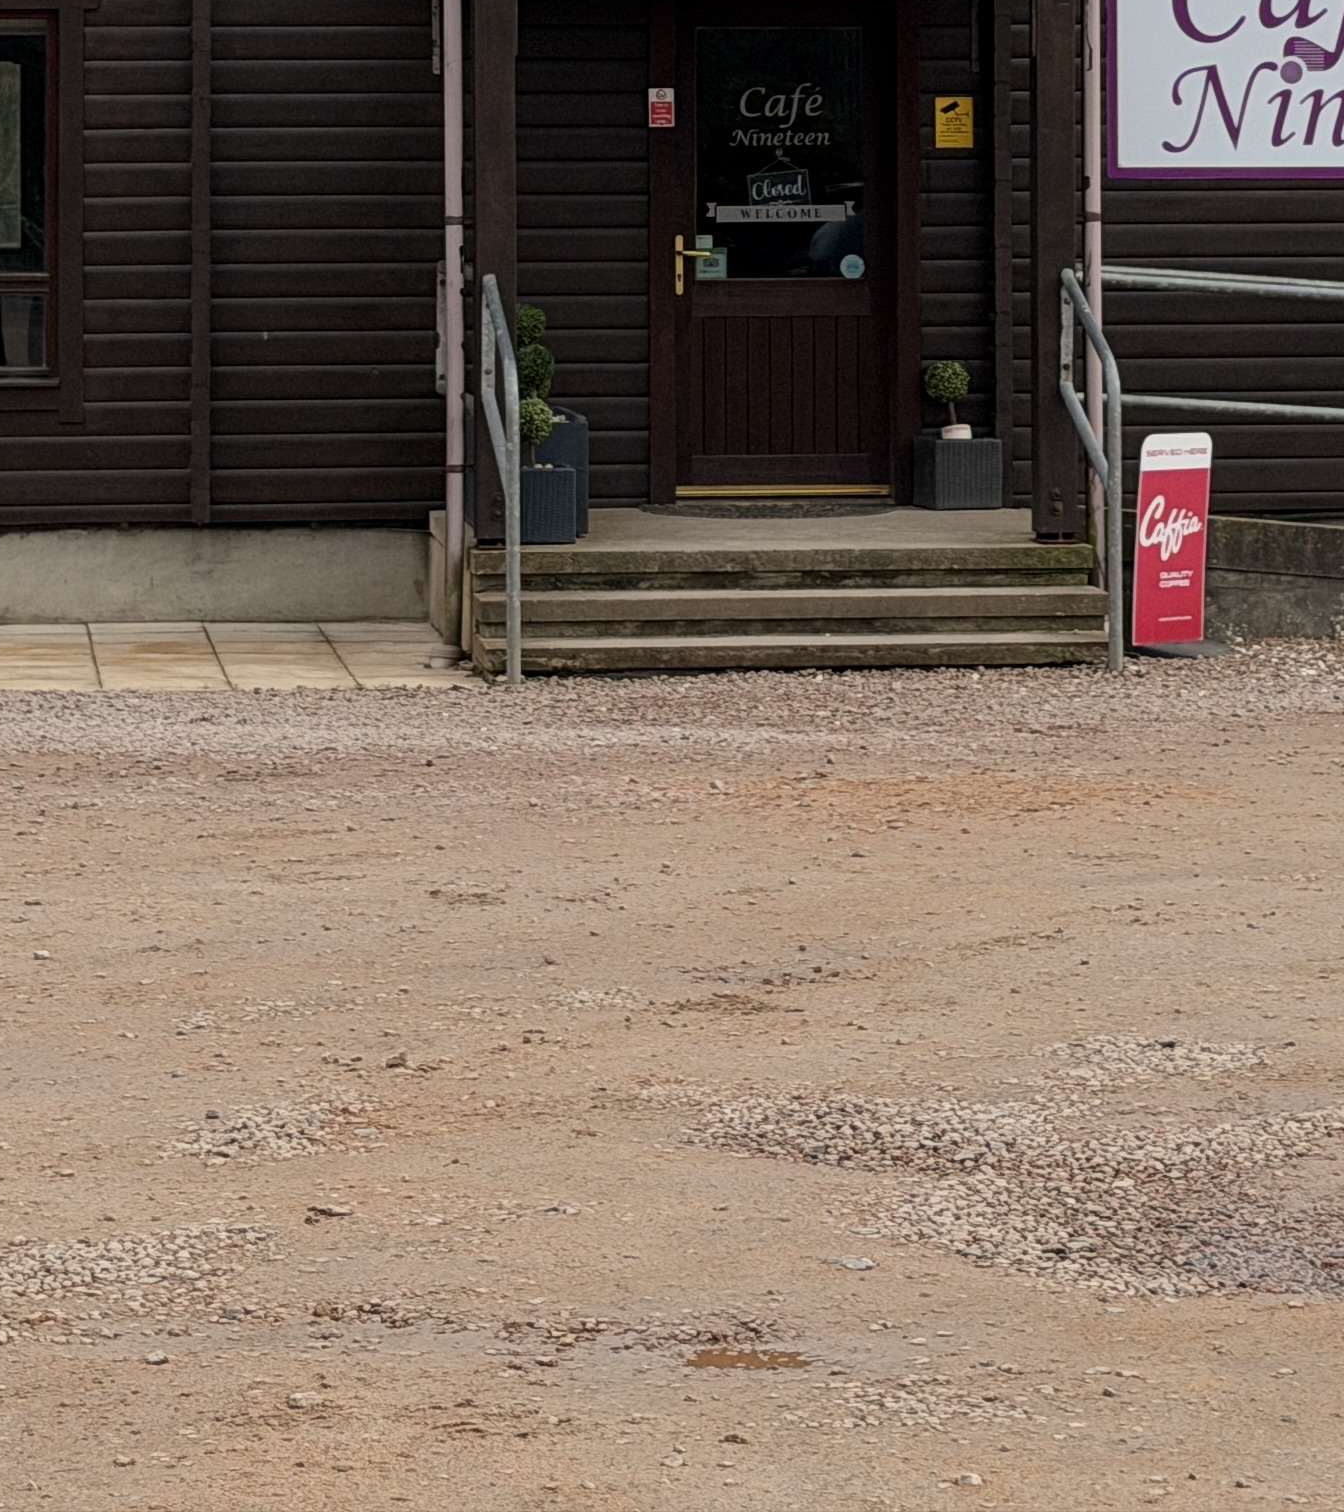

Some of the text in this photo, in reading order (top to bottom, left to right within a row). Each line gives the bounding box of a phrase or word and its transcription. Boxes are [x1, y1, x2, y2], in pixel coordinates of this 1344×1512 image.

[739, 82, 824, 129] Café
[729, 128, 832, 147] Nineteen
[752, 174, 807, 200] Closed
[740, 207, 823, 220] WELCOME
[1145, 448, 1183, 458] SERVED
[1159, 569, 1194, 579] QUALITY
